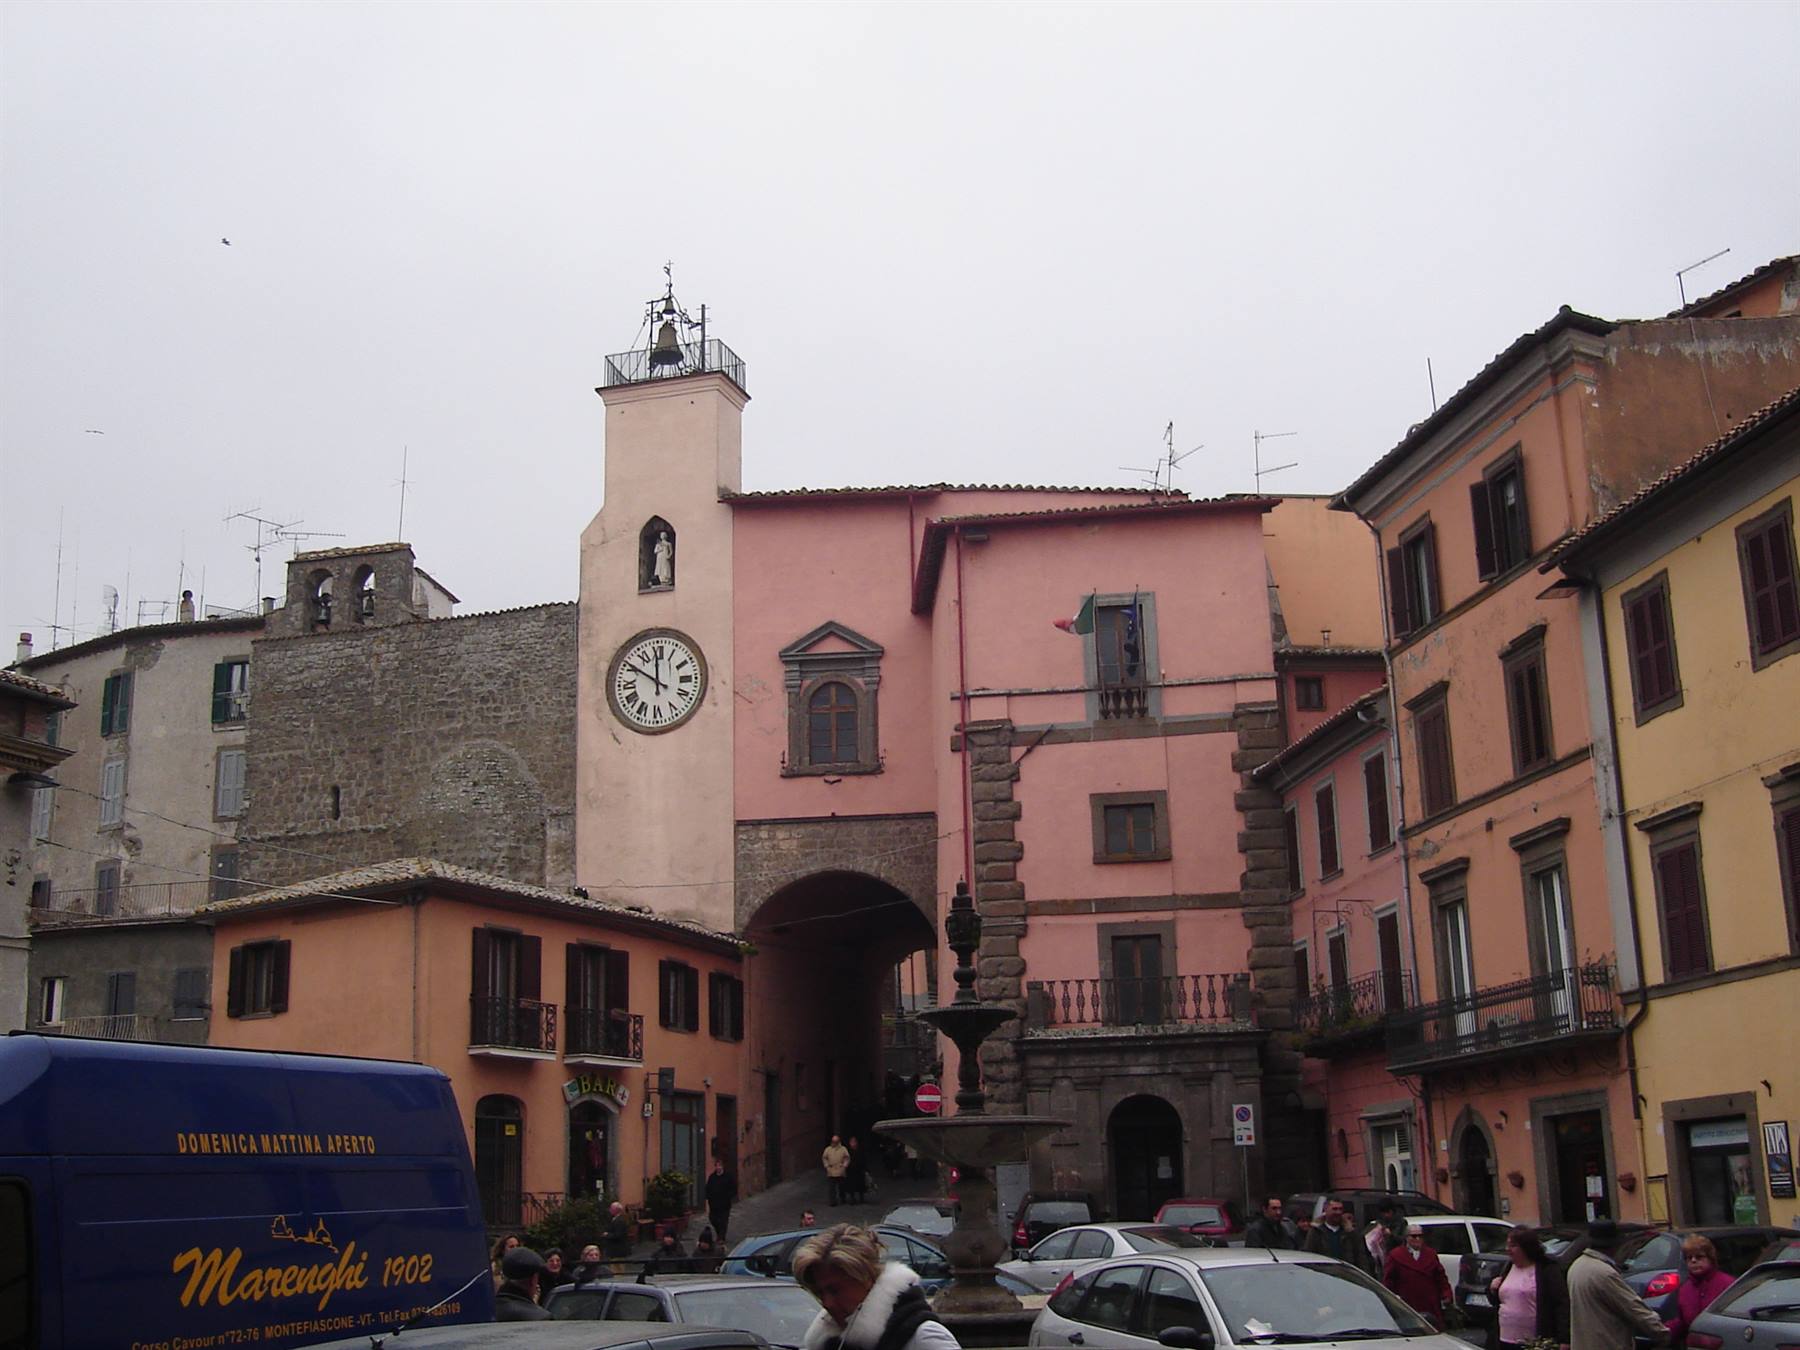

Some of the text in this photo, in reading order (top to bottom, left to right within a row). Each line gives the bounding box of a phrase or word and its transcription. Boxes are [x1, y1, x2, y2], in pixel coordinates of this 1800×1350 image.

[578, 1073, 615, 1097] BAR
[177, 1132, 376, 1154] DOMENICA MATTINA APERTO
[172, 1240, 434, 1312] Marenghi 1902
[132, 1341, 169, 1350] Corso
[172, 1335, 215, 1350] Cavour
[264, 1315, 354, 1339] MONTEFIASCONE
